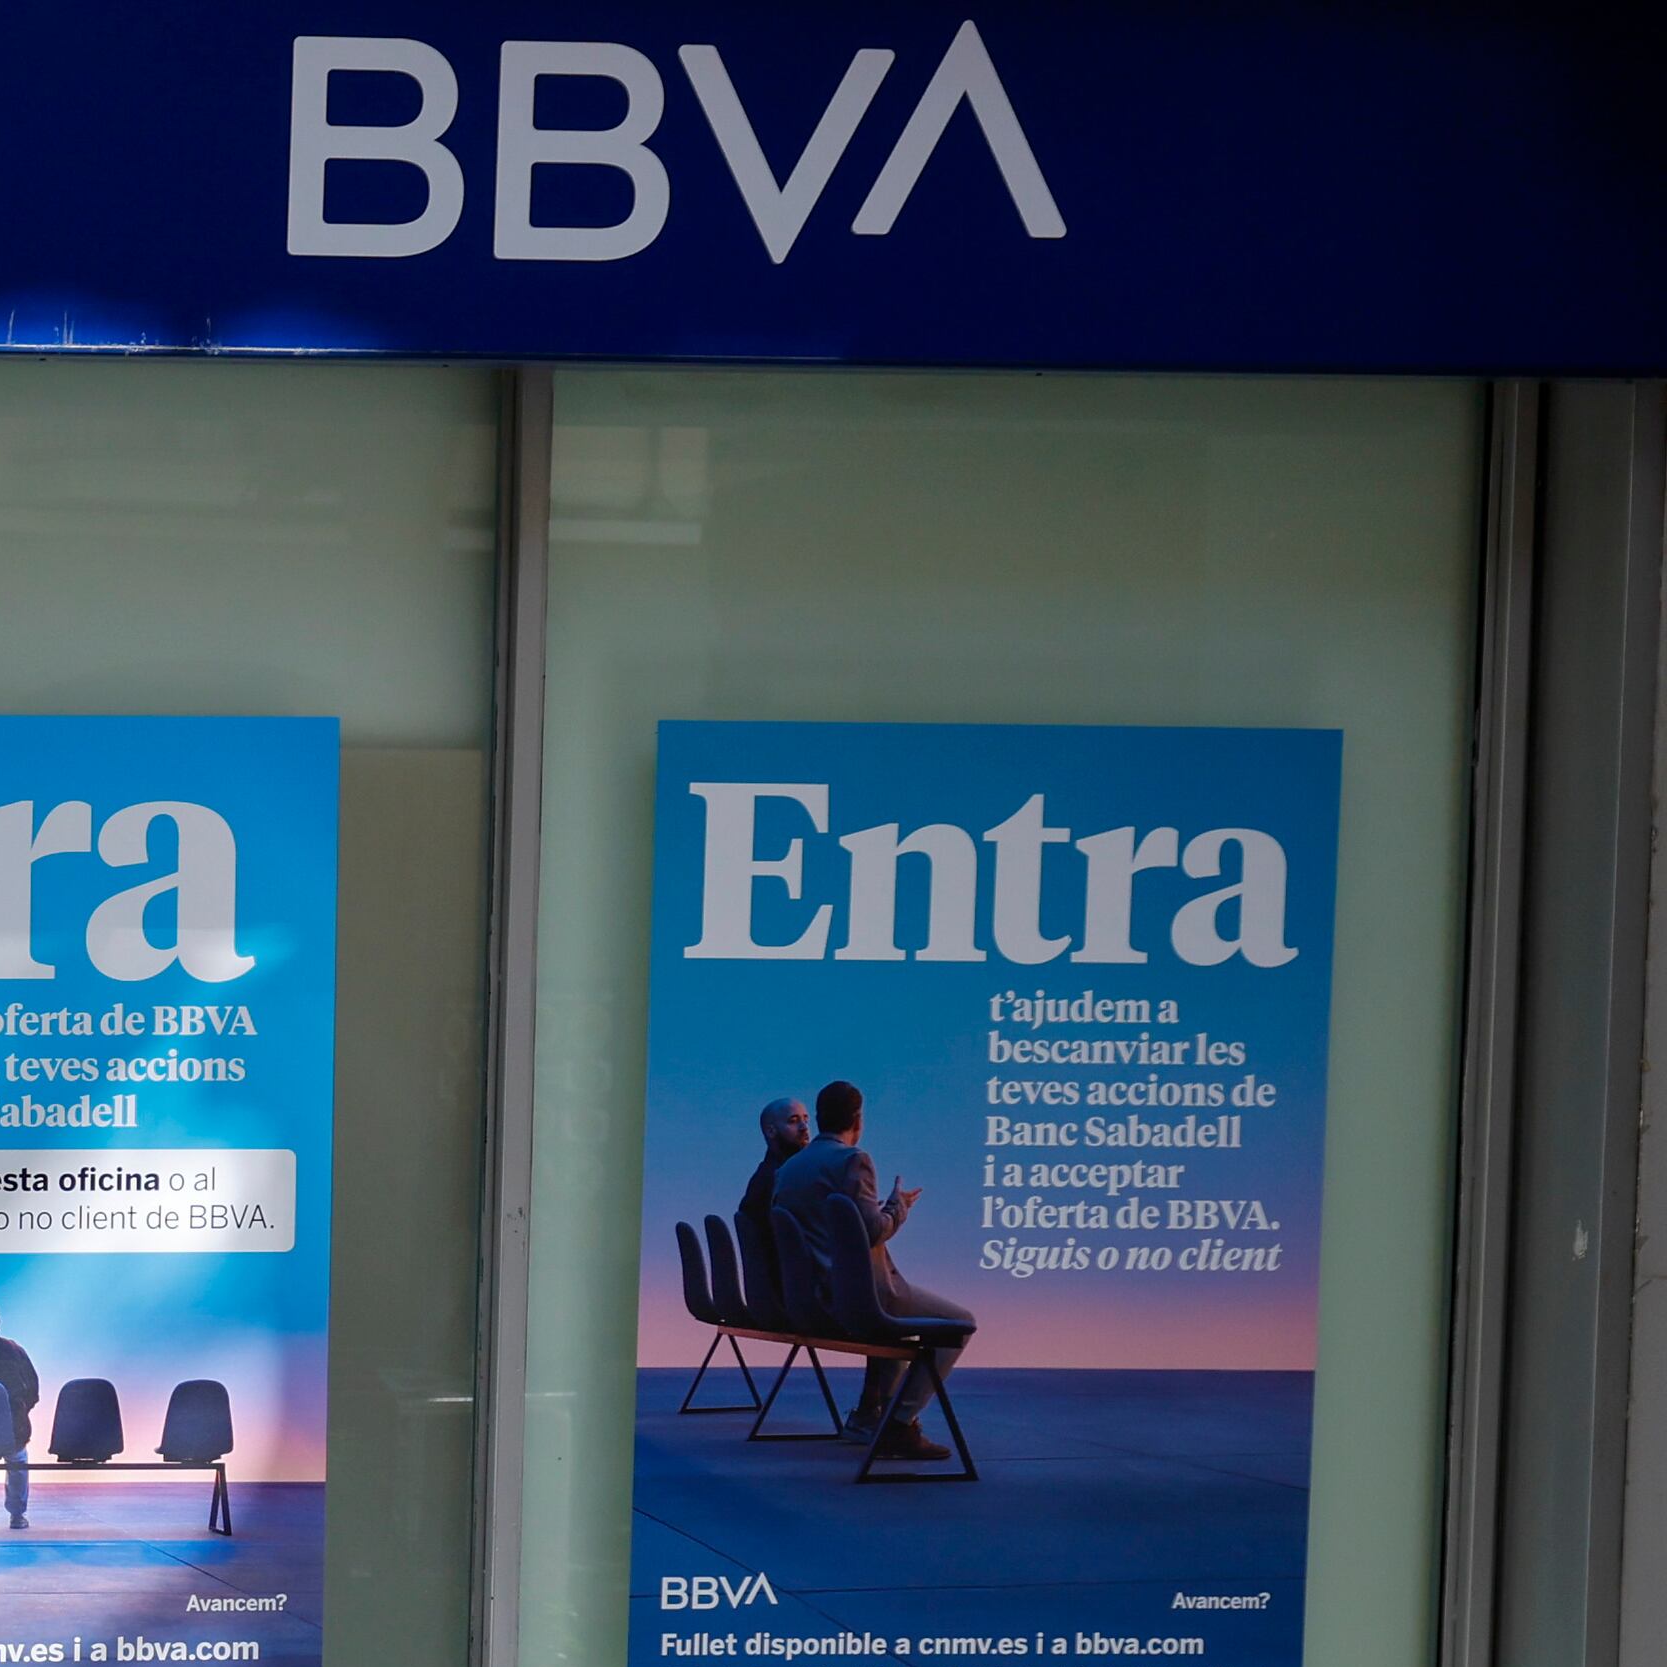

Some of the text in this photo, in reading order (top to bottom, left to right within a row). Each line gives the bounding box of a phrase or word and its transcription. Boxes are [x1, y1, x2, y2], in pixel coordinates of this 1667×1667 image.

[287, 19, 1067, 264] BBVA
[683, 782, 1299, 968] Entra
[100, 1004, 145, 1035] de
[153, 1006, 257, 1035] BBVA
[990, 990, 1179, 1030] t'ajudem a
[989, 1031, 1245, 1065] bescanviar les
[5, 1054, 99, 1081] teves
[107, 1049, 245, 1082] accions
[987, 1074, 1276, 1107] teves accions de
[985, 1114, 1241, 1148] Banc Sabadell
[59, 1167, 159, 1191] oficina
[170, 1174, 184, 1190] o
[195, 1168, 214, 1190] al
[983, 1155, 1185, 1196] i a acceptar
[20, 1212, 52, 1229] no
[62, 1206, 136, 1229] client
[147, 1206, 178, 1229] de
[191, 1205, 276, 1230] BBVA.
[982, 1196, 1279, 1230] l'oferta de BBVA.
[980, 1238, 1283, 1278] Siguis o no client
[186, 1594, 287, 1612] Avancem?
[661, 1572, 779, 1610] BBVA
[1171, 1592, 1270, 1610] Avancem?
[74, 1637, 80, 1661] i
[91, 1644, 107, 1661] a
[117, 1636, 259, 1661] bbva.com
[662, 1632, 1203, 1660] Fullet disponible a cnmv.es i a bbva.com
